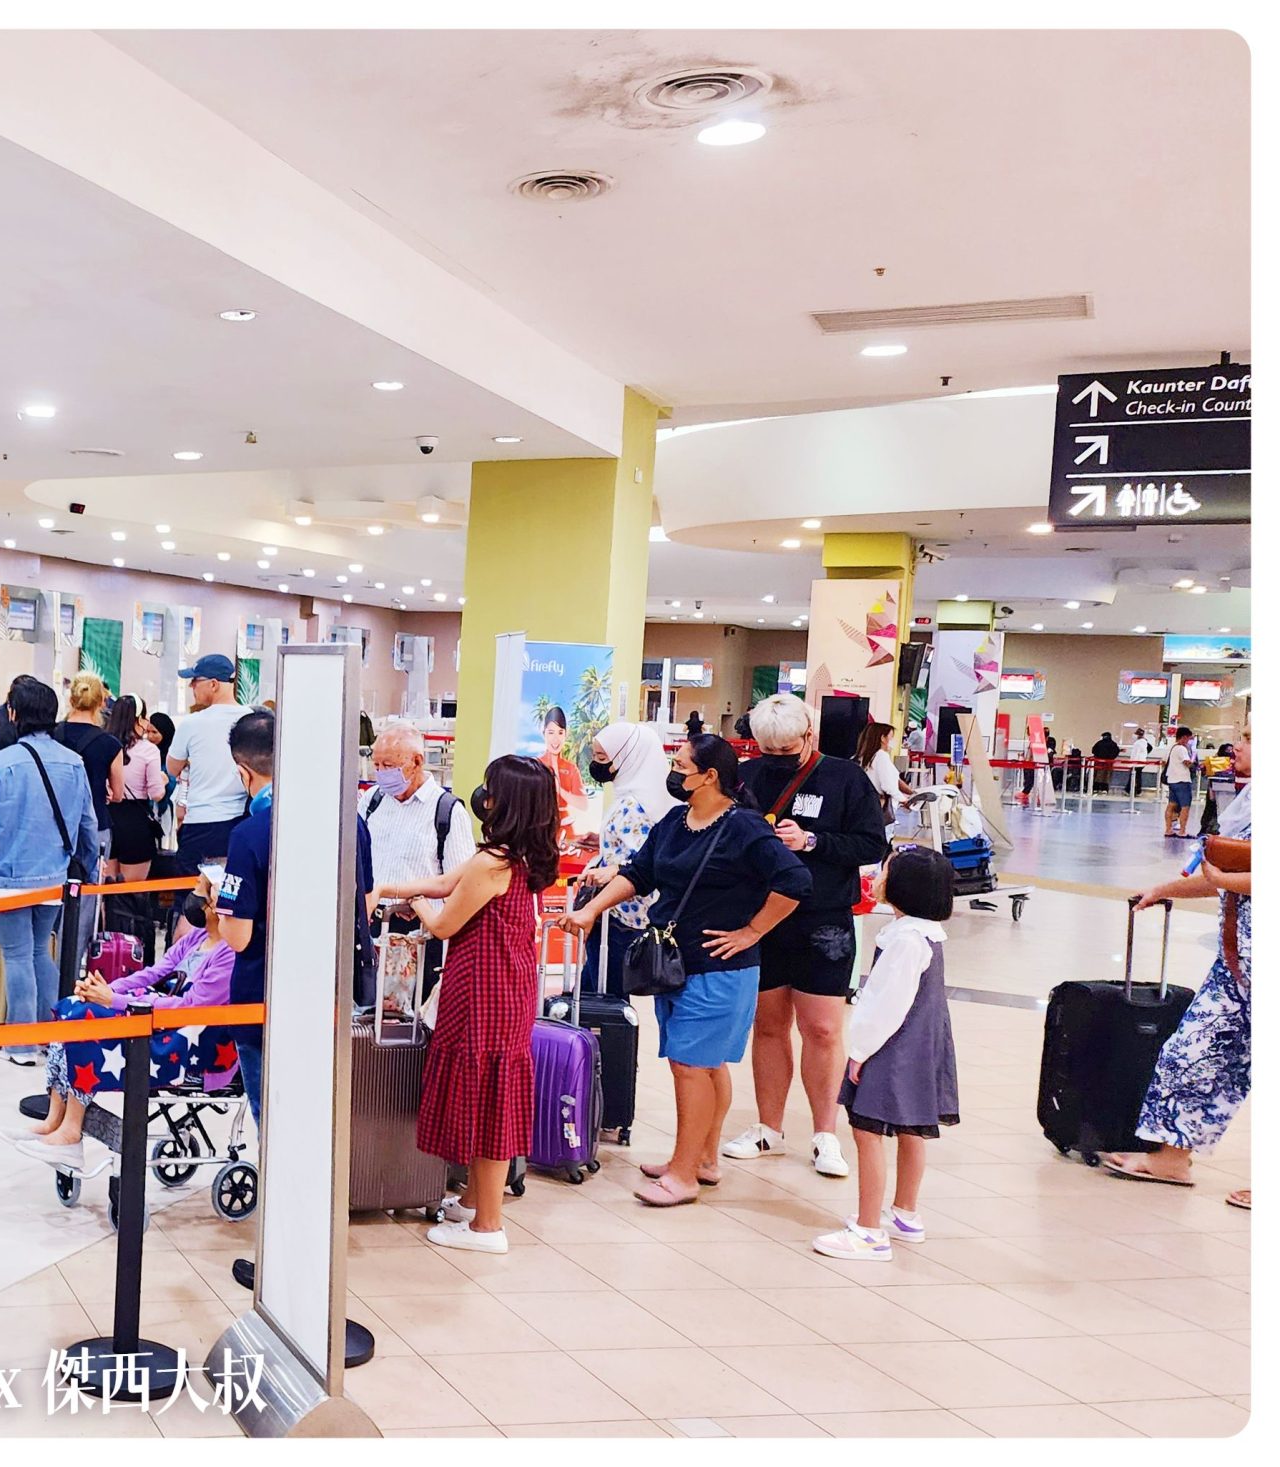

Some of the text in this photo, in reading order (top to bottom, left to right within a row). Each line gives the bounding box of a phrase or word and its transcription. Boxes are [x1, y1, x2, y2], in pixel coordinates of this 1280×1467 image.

[1126, 380, 1206, 395] Kaunter
[1125, 400, 1196, 415] Check-in
[530, 659, 564, 676] firefly
